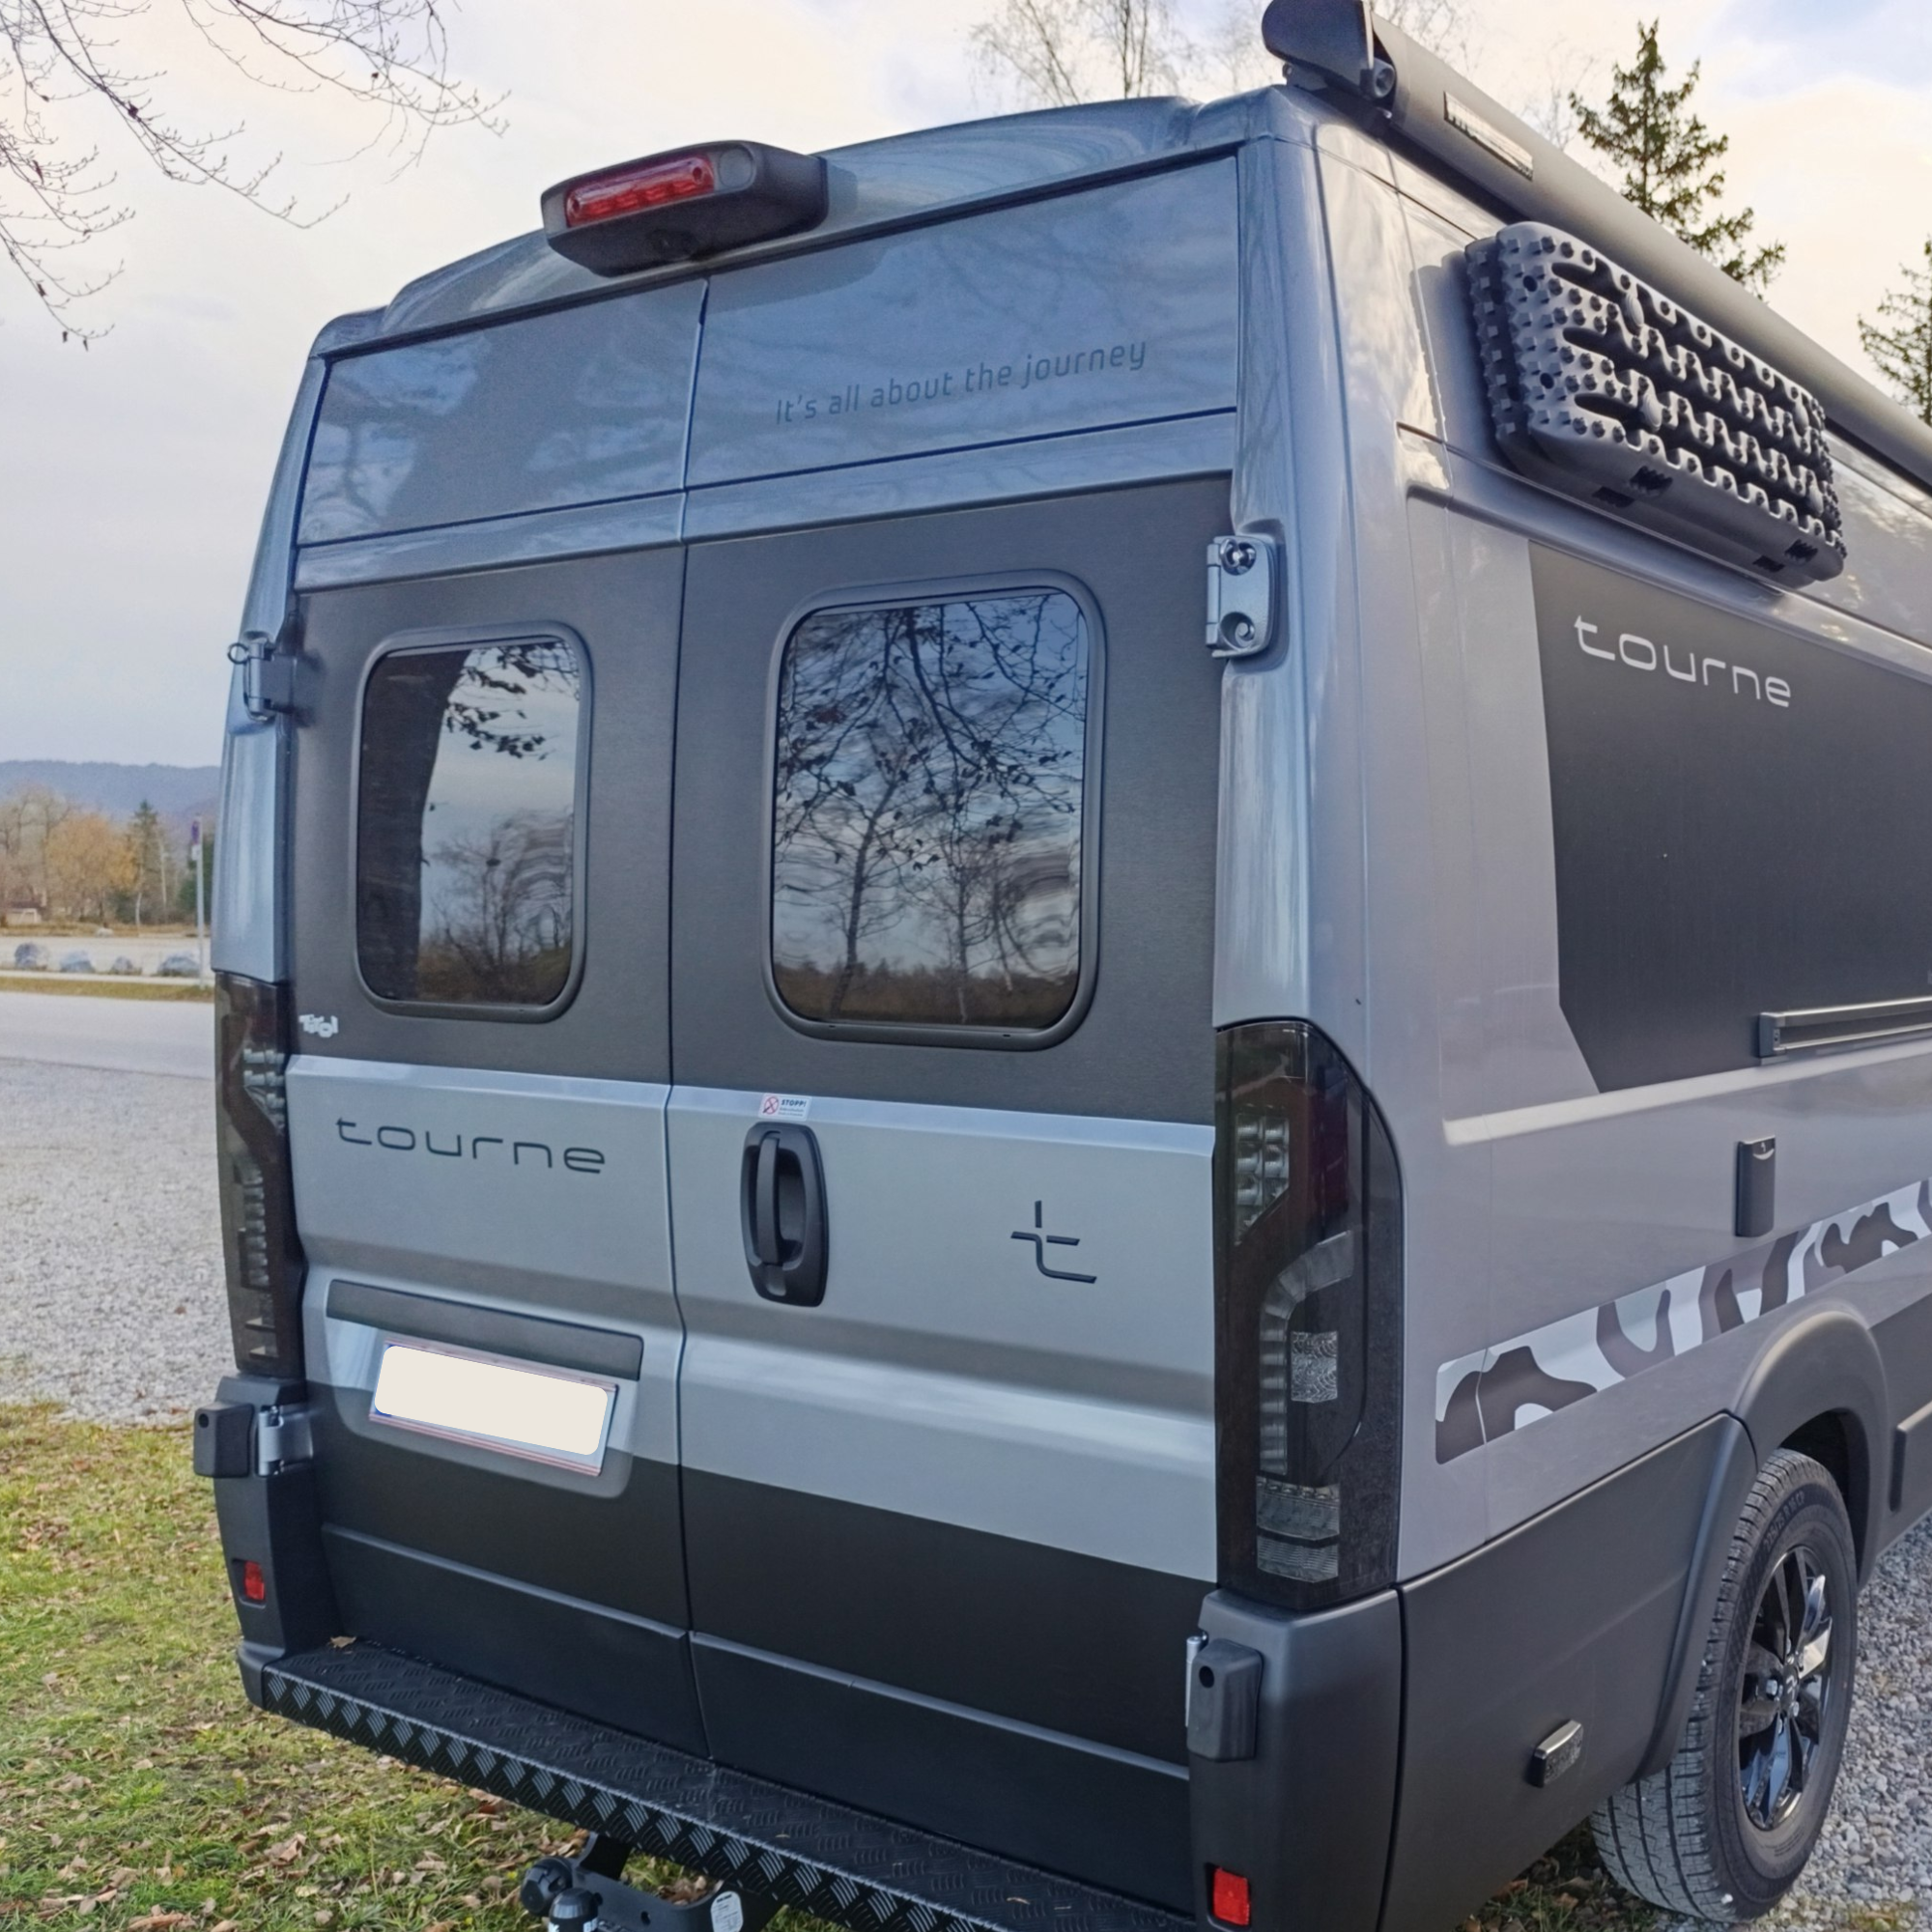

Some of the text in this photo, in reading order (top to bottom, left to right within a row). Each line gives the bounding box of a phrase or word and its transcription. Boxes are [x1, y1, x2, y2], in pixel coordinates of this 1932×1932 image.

[829, 384, 860, 415] all
[870, 372, 953, 409] about
[965, 362, 1012, 393] the
[1021, 341, 1147, 389] journey
[1574, 614, 1792, 708] tourne
[335, 1118, 606, 1175] tourne
